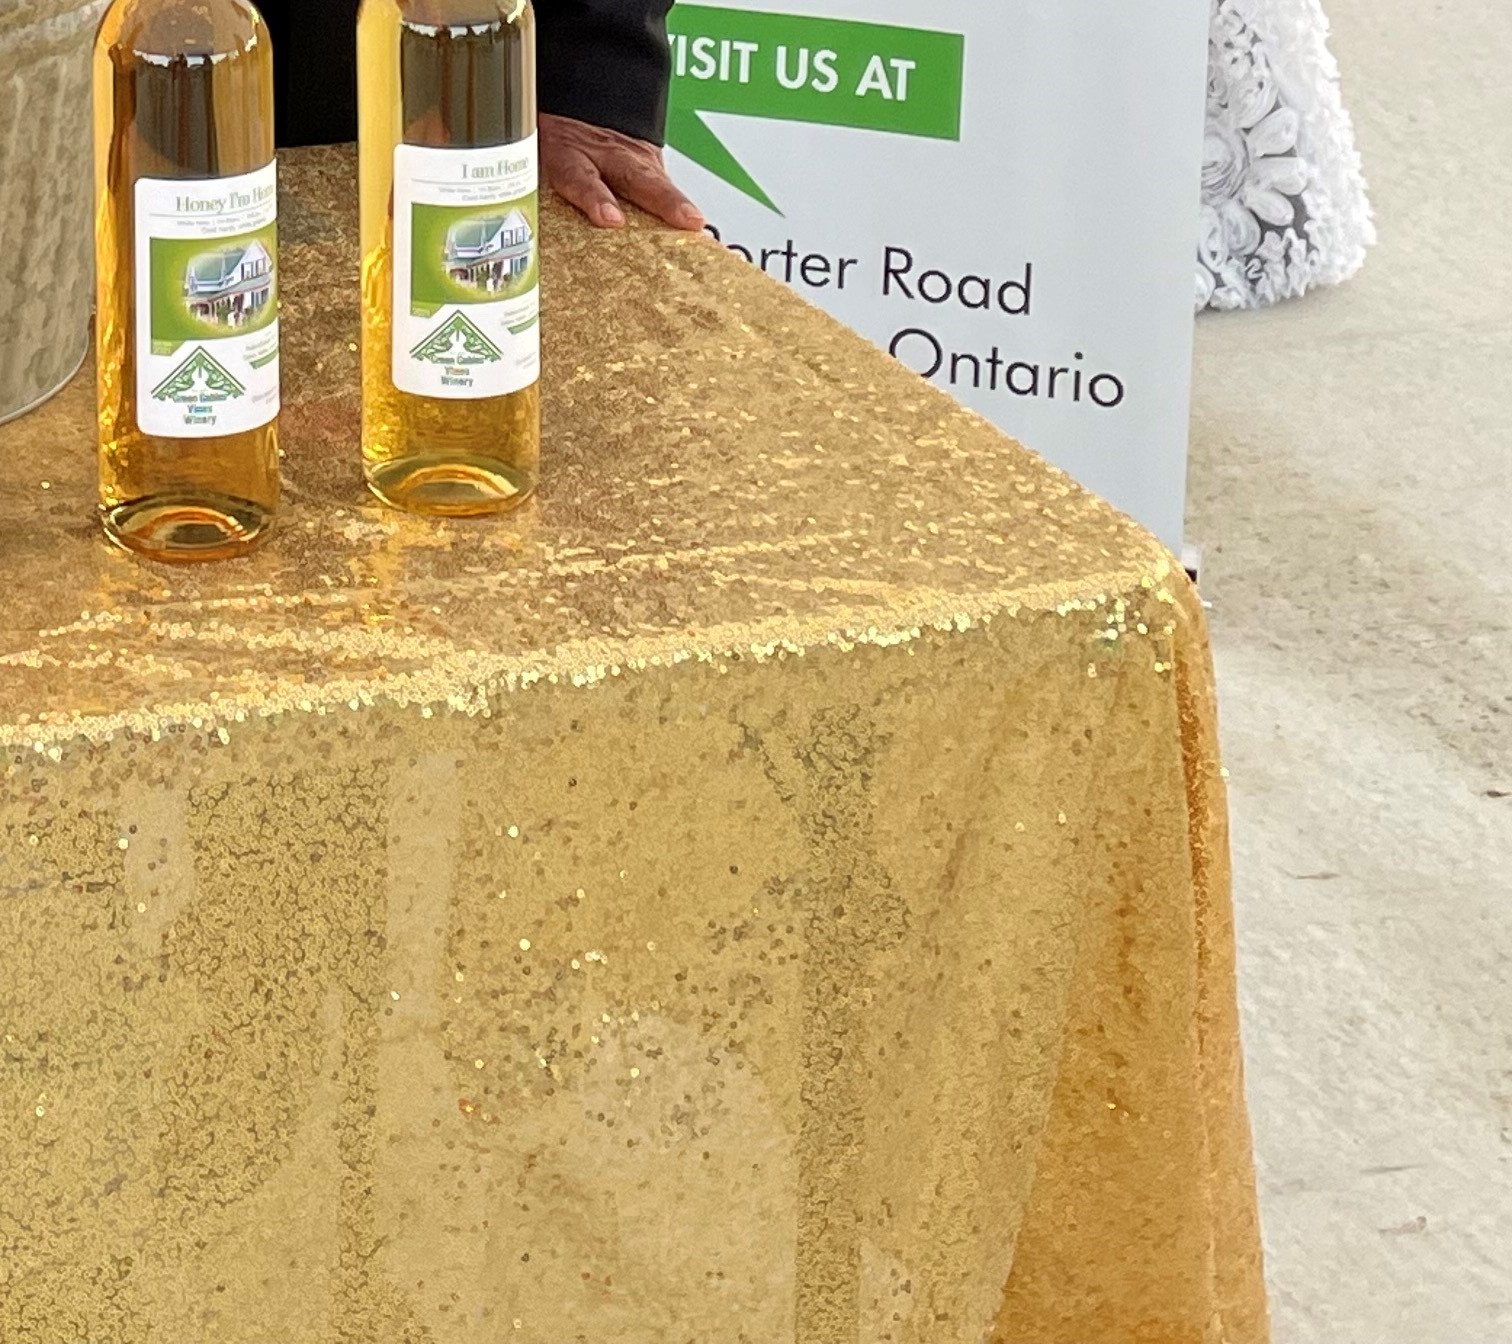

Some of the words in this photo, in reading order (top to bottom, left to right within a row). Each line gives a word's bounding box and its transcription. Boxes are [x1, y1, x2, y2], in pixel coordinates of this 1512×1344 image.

[776, 45, 839, 93] US
[855, 55, 916, 101] AT
[471, 166, 495, 179] am
[176, 196, 227, 213] Honey
[703, 223, 858, 290] rter
[882, 245, 1032, 316] Road
[889, 327, 1125, 408] Ontario
